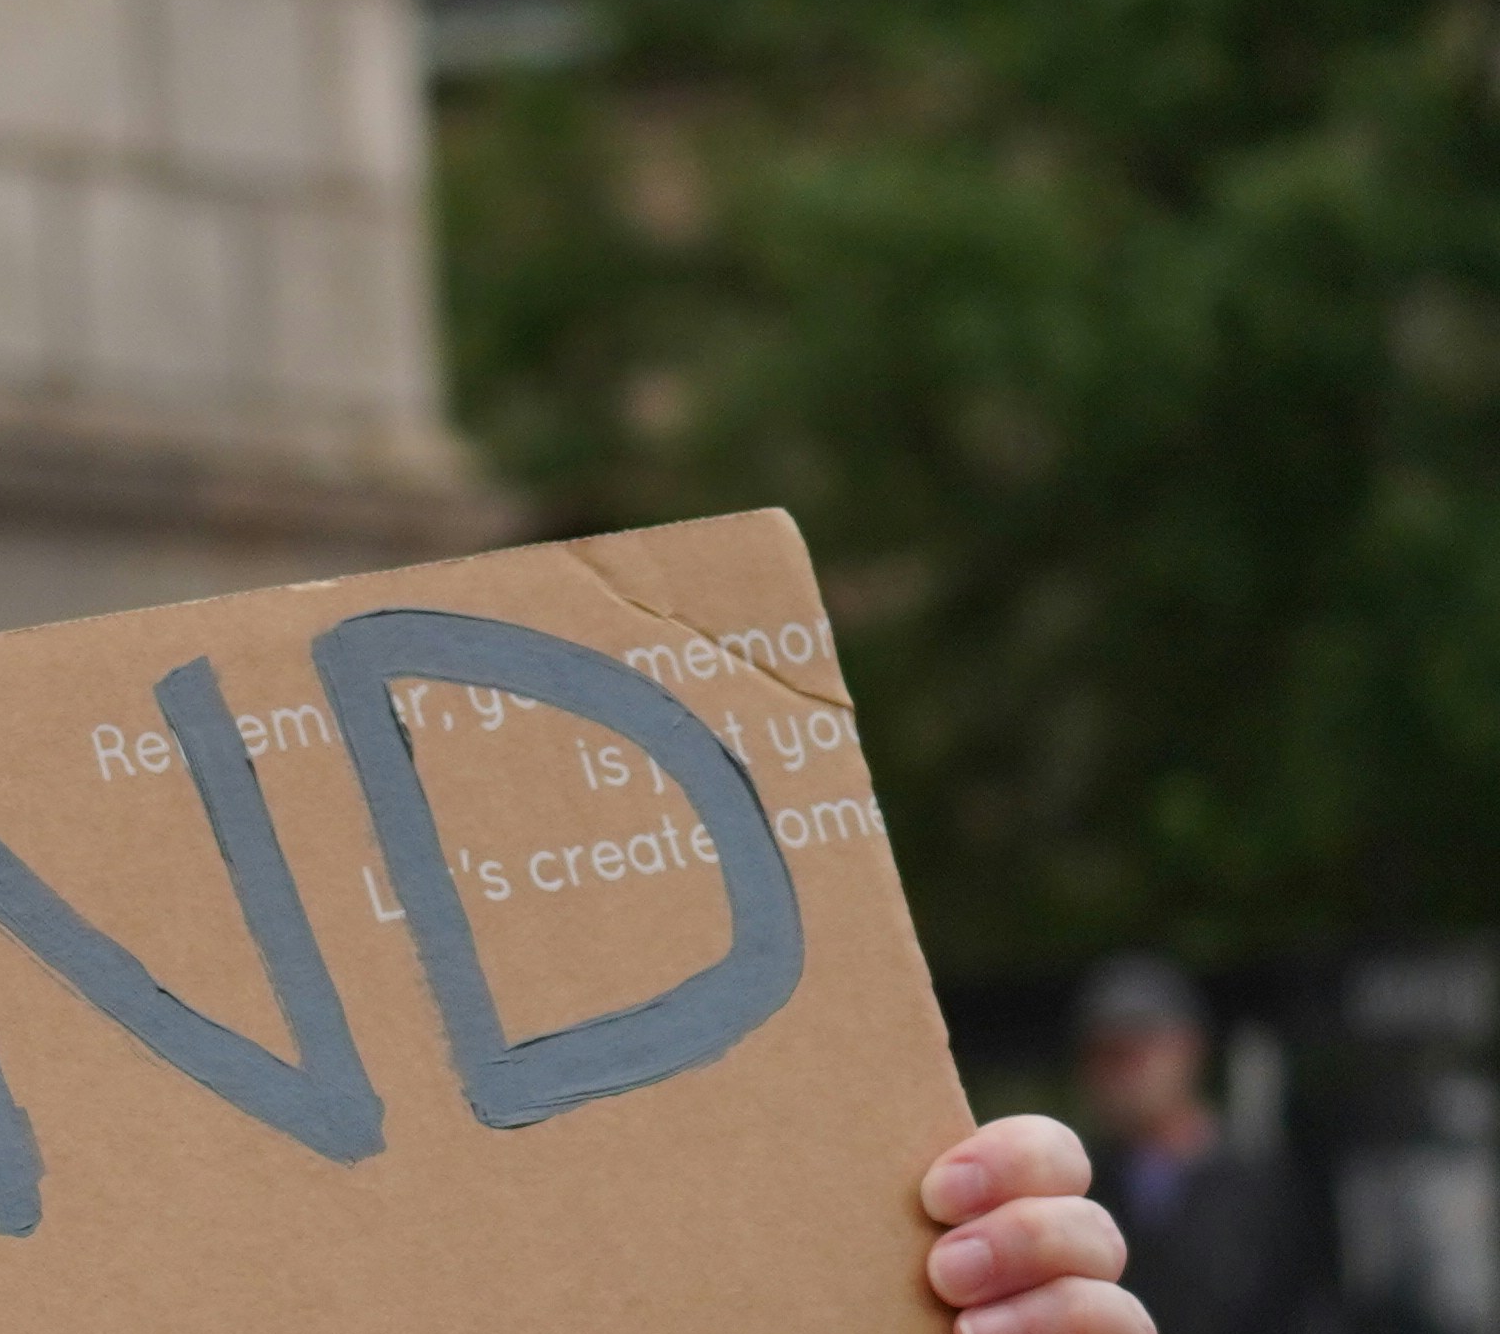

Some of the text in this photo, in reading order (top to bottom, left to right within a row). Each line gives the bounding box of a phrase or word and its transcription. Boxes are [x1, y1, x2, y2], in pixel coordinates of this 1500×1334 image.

[91, 684, 454, 781] Reemr,
[576, 738, 631, 790] is
[362, 848, 512, 924] L's
[529, 813, 719, 893] create
